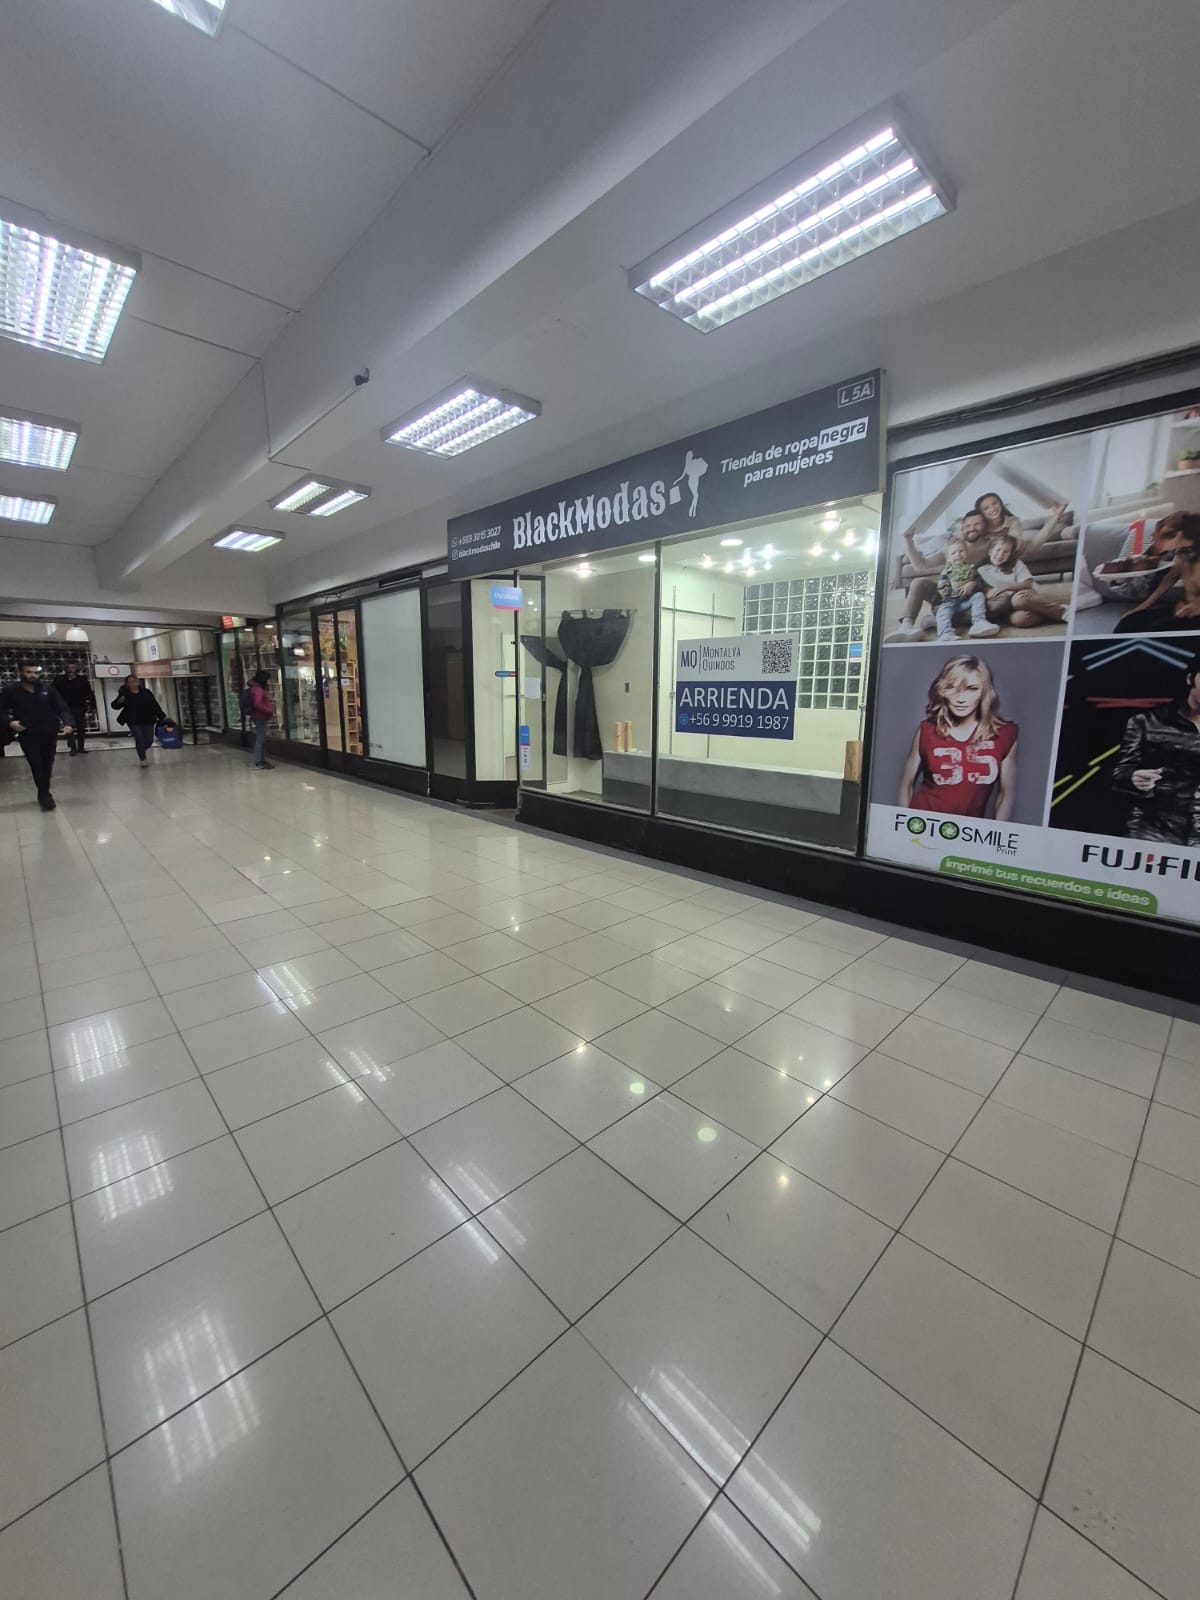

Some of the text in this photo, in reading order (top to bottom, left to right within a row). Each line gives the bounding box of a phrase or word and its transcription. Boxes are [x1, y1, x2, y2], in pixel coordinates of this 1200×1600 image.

[840, 383, 871, 404] L 5A
[720, 421, 866, 473] Tienda de ropa negra
[743, 450, 834, 488] para mujeres
[512, 480, 666, 550] BlackModas
[680, 650, 698, 669] MQ
[679, 687, 789, 710] ARRIENDA
[689, 713, 789, 730] +56 9 9919 1987
[932, 740, 999, 785] 35
[894, 813, 1020, 850] FOTOSMILE
[996, 846, 1017, 857] Print
[995, 868, 1019, 881] tus
[1020, 874, 1091, 895] recuerdos
[1094, 887, 1104, 897] e
[1106, 888, 1150, 906] ideas
